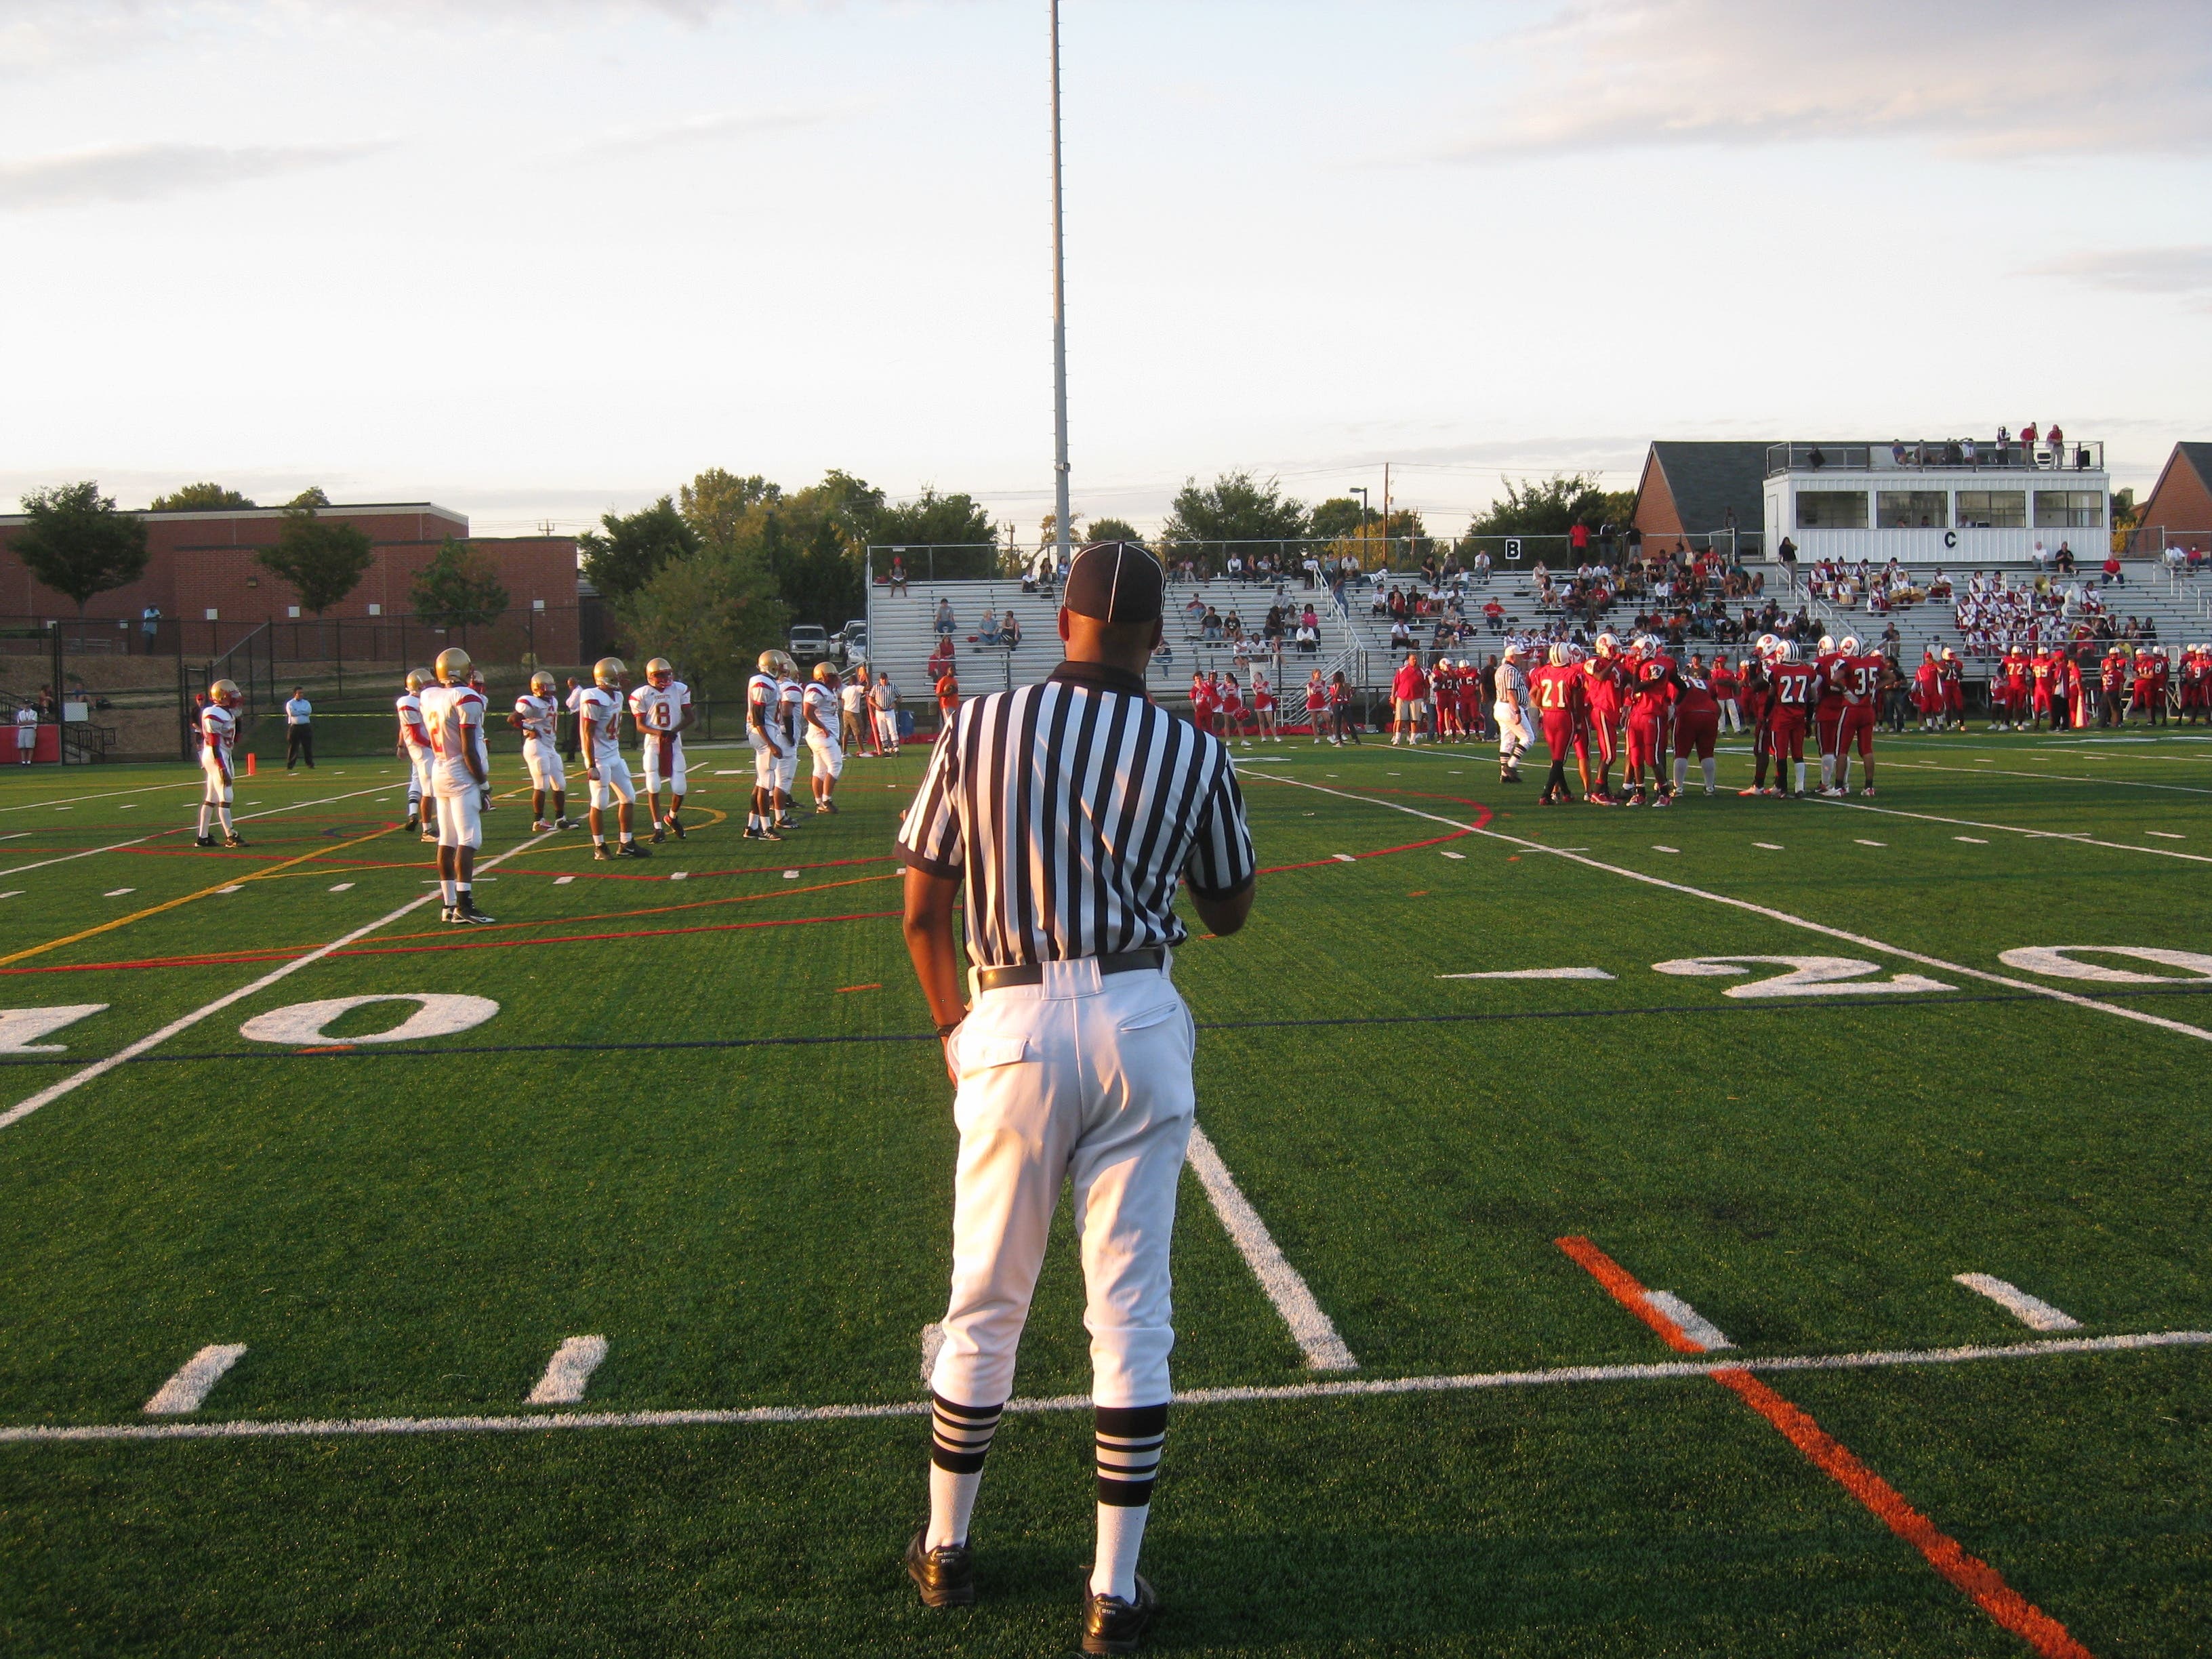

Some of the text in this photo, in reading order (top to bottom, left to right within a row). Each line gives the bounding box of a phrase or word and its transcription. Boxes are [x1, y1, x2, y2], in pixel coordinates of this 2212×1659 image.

[1944, 531, 1957, 548] C
[1507, 541, 1519, 557] B
[2007, 663, 2023, 676] 72
[2033, 665, 2048, 678] 85
[2154, 662, 2161, 674] 8
[2194, 667, 2201, 678] 9
[1854, 667, 1877, 695] 35
[2102, 674, 2113, 686] 65
[1541, 679, 1565, 708] 21
[1780, 675, 1807, 703] 27
[656, 702, 670, 727] 8
